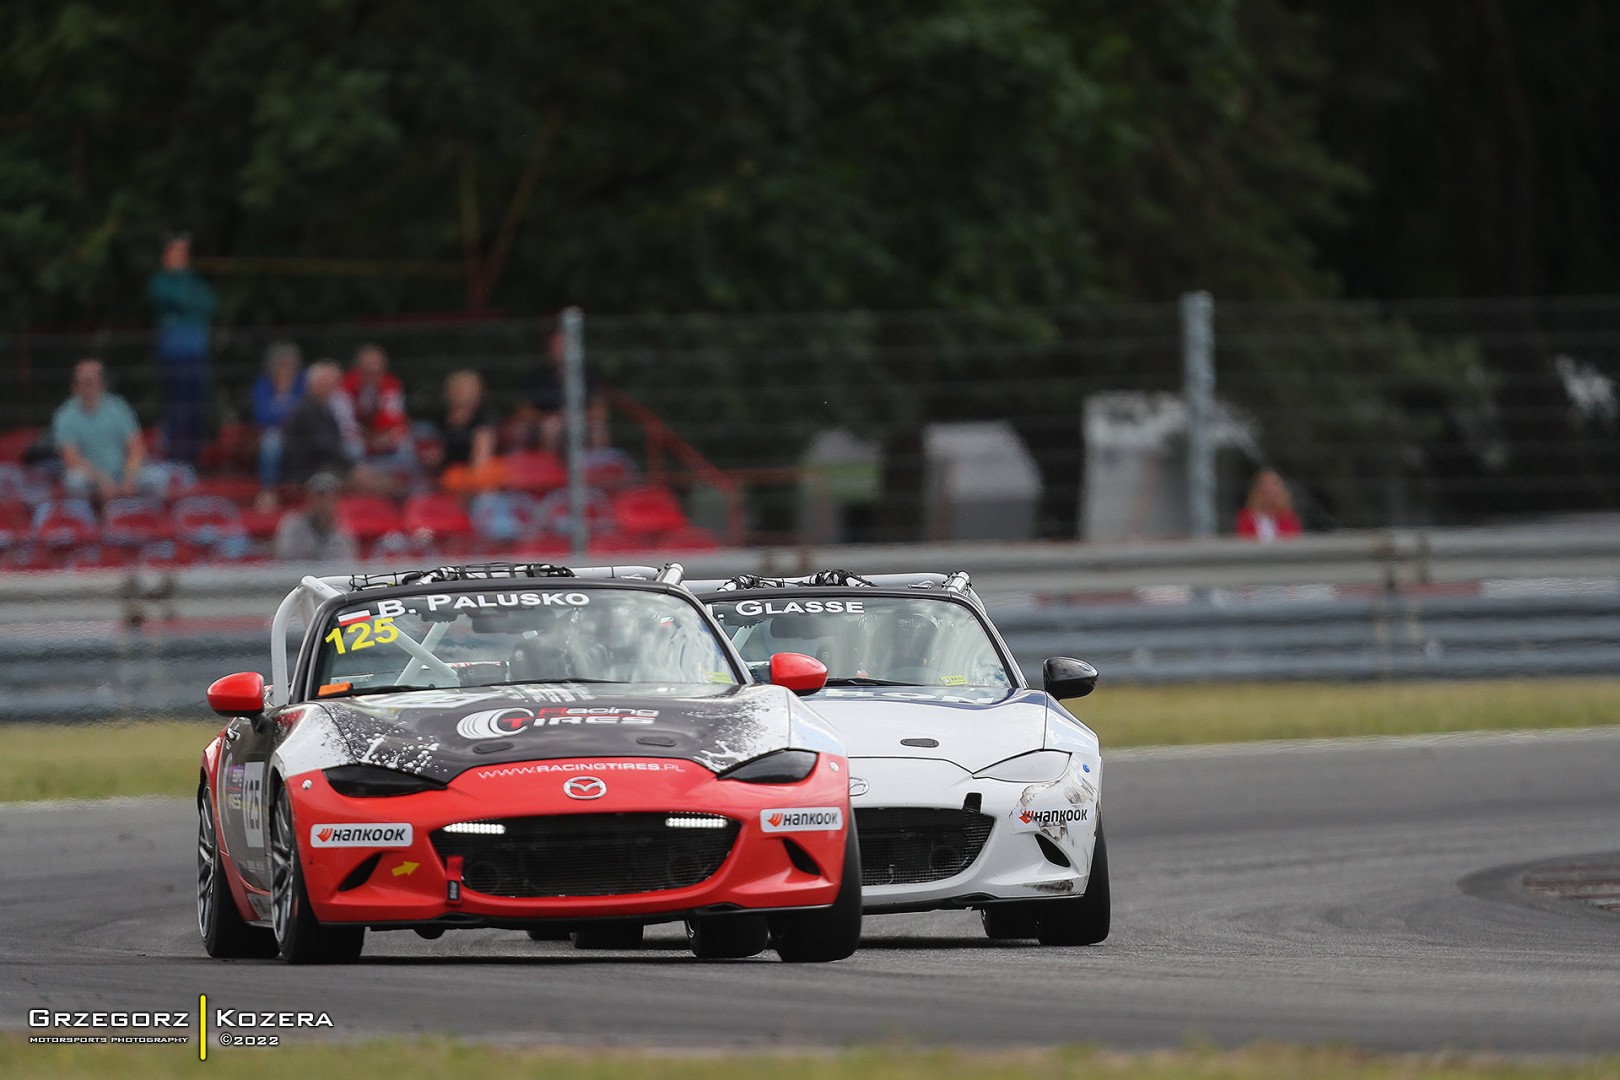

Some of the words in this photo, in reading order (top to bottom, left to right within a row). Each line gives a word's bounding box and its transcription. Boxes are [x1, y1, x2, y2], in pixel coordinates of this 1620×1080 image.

[377, 600, 417, 618] B.
[426, 593, 590, 611] PALUSKO
[735, 600, 865, 616] GLASSE
[325, 617, 399, 655] 125
[537, 706, 660, 717] Racing
[477, 762, 686, 780] WWW.RACINGTIRES.PL
